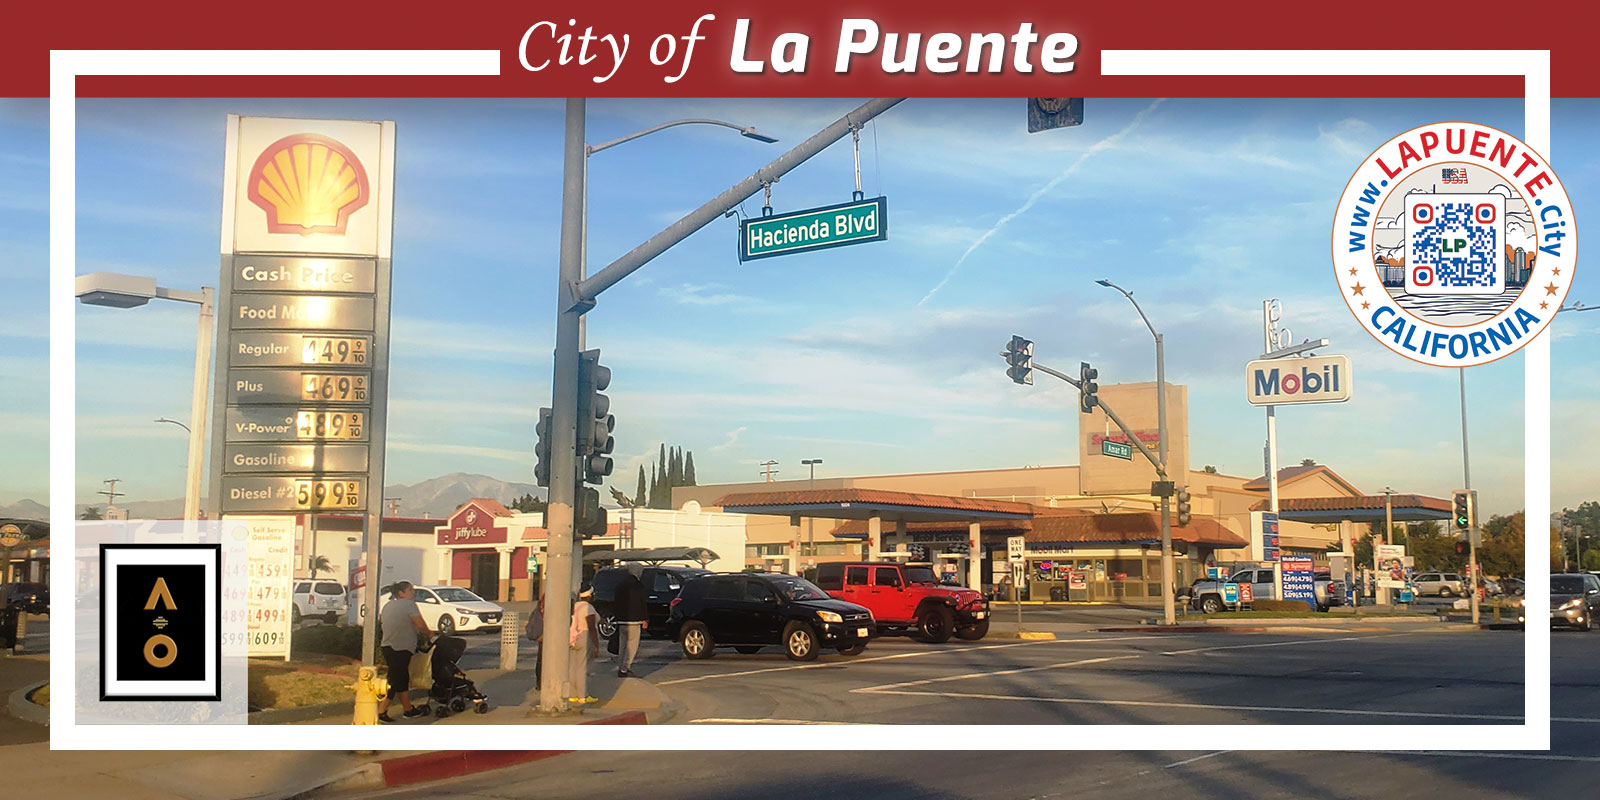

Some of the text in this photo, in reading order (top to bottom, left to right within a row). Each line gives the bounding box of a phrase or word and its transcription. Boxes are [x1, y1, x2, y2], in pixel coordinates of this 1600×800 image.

[751, 209, 875, 249] Hacienda Blvd
[241, 265, 354, 284] Cash Price
[239, 305, 314, 319] Food Ma
[238, 343, 289, 356] Regular
[1254, 364, 1339, 396] Mobil
[236, 381, 263, 392] Plus
[305, 377, 350, 399] 469
[235, 423, 289, 433] V-Power
[233, 453, 296, 466] Gasoline
[230, 487, 272, 499] Diesel
[275, 487, 294, 499] #2
[297, 483, 345, 506] 599
[258, 564, 281, 577] 459
[257, 587, 280, 600] 479
[256, 609, 278, 622] 499
[221, 632, 244, 645] 599
[255, 632, 278, 645] 609
